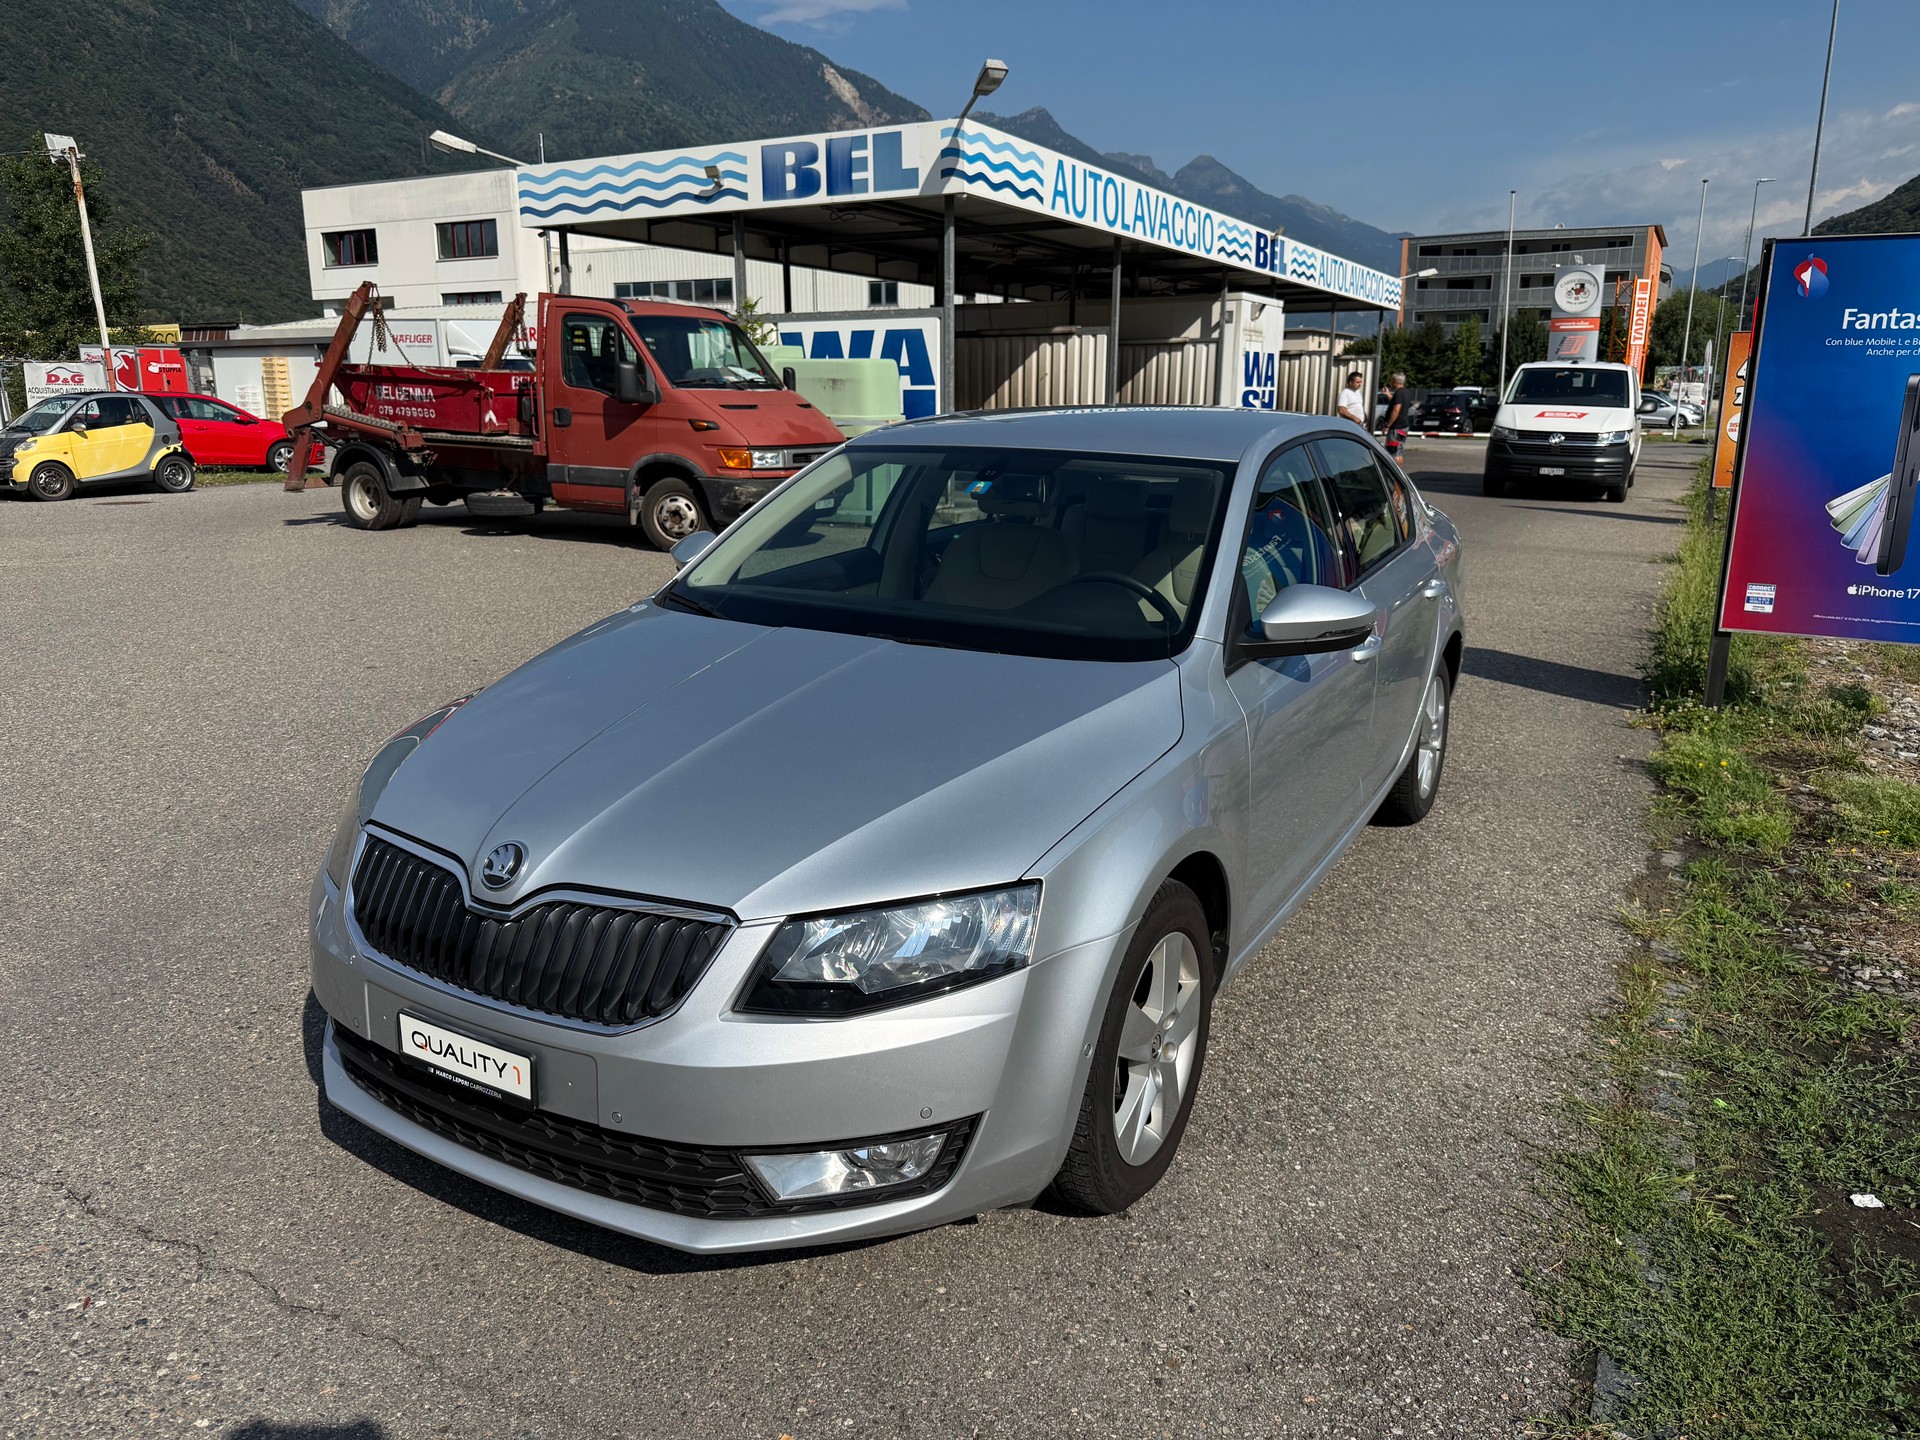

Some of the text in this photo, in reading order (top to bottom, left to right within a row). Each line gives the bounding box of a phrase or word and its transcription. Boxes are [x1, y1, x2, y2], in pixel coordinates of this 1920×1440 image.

[761, 130, 919, 202] BEL
[1051, 159, 1384, 303] AUTOLAVAGGIO BEL AUTOLAVAGGIO
[1632, 297, 1647, 343] TADDEI
[1825, 338, 1842, 346] Con
[1845, 338, 1864, 346] blue
[1865, 338, 1896, 346] Mobile
[1898, 338, 1903, 346] L
[1865, 348, 1895, 356] Anche
[1896, 349, 1911, 358] per
[46, 373, 85, 384] D&G
[1244, 351, 1275, 387] WA
[378, 405, 394, 416] 079
[1748, 584, 1775, 592] connect
[1858, 585, 1904, 599] iPhone
[411, 1030, 508, 1078] QUALITY
[435, 1069, 503, 1099] MARCO LEPORI CARROZZERIA
